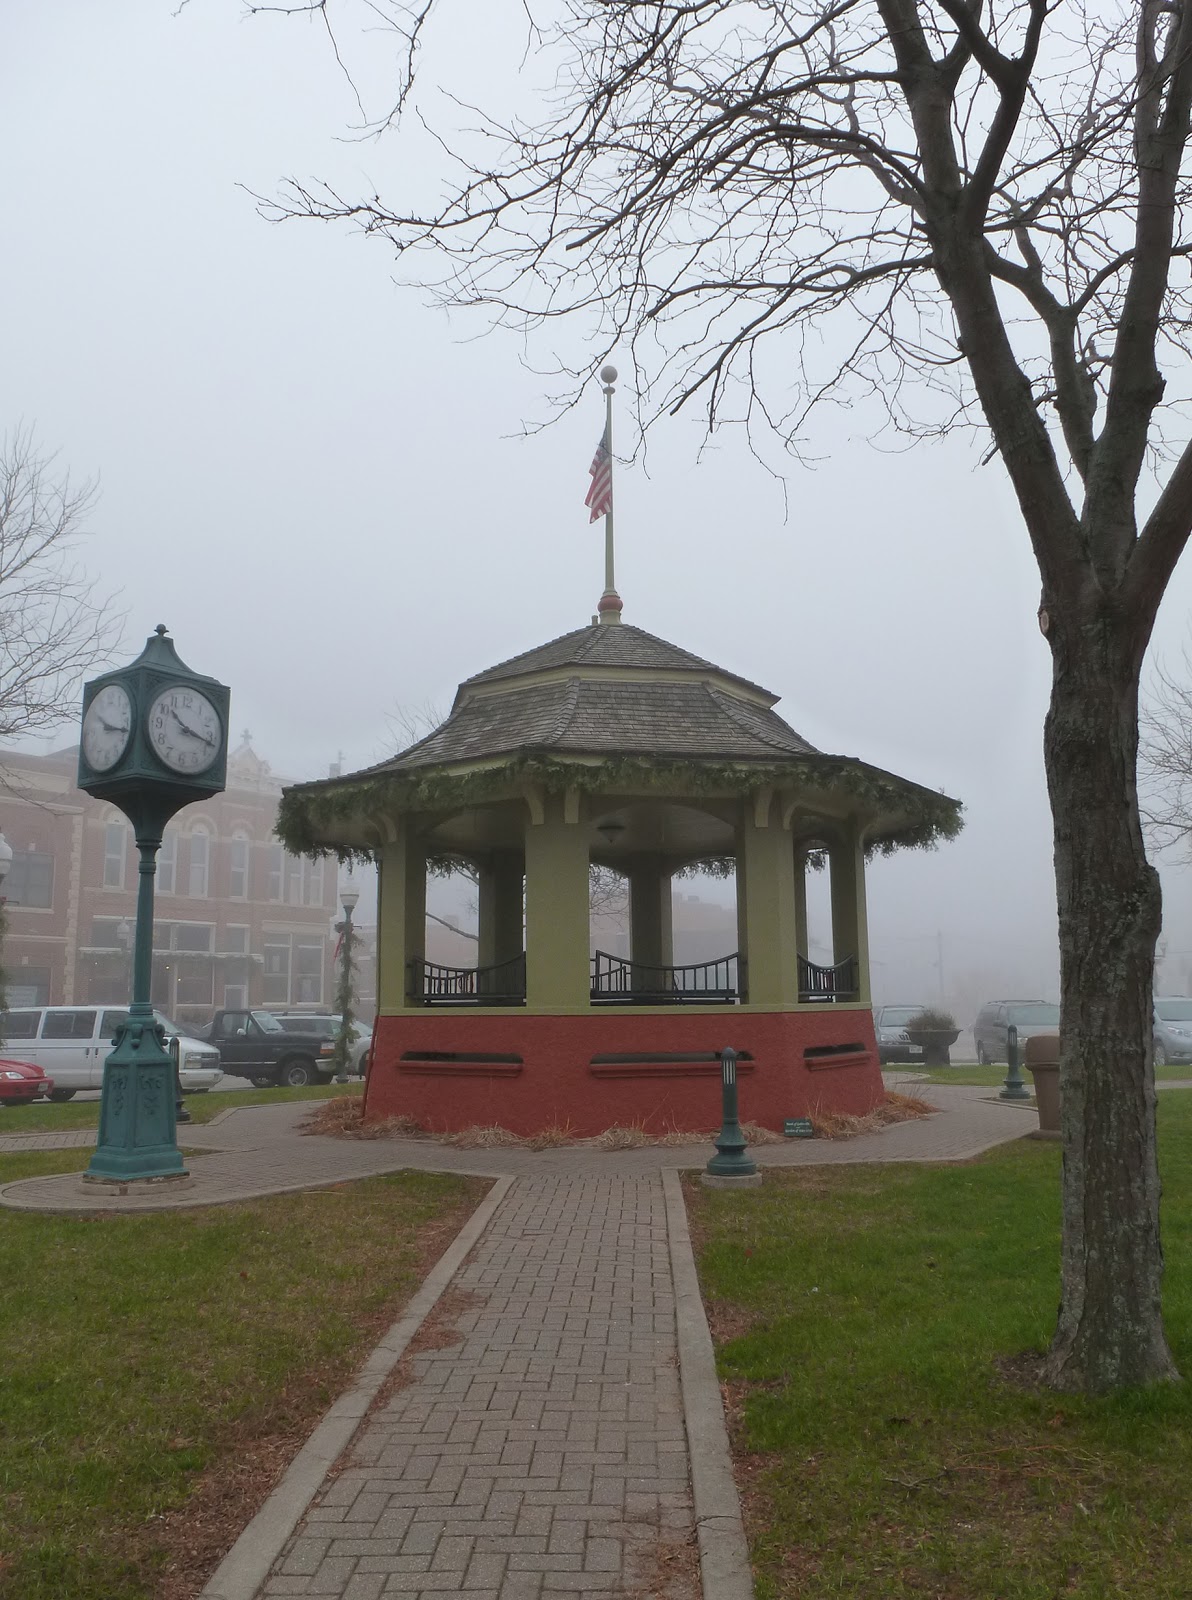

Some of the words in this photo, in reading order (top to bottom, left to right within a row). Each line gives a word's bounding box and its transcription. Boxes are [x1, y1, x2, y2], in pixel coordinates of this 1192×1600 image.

[182, 695, 193, 709] 12
[160, 703, 170, 715] 10
[155, 716, 163, 729] 9
[157, 732, 165, 745] 8
[166, 746, 174, 759] 7
[178, 752, 185, 765] 6
